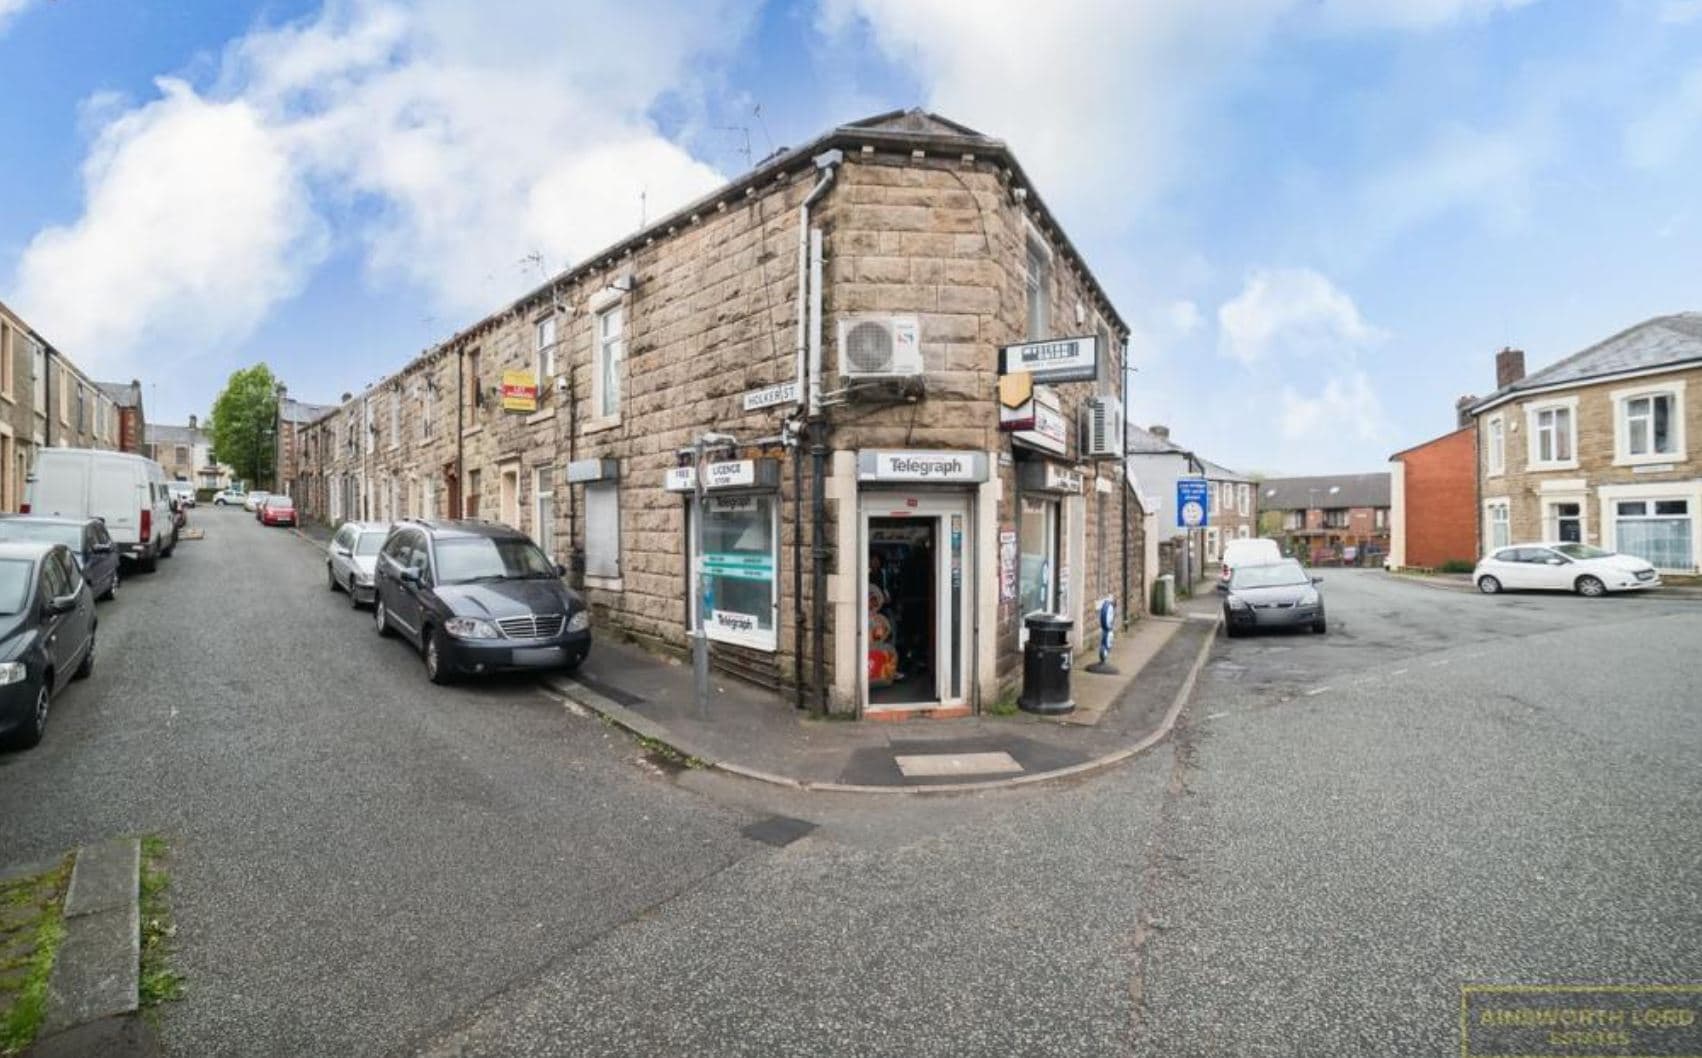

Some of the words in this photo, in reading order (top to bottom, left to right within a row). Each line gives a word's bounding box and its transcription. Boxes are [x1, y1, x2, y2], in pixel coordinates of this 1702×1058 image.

[783, 385, 795, 400] ST
[712, 463, 741, 476] LICENCE
[890, 457, 962, 476] Telegraph
[717, 613, 753, 631] Telegraph
